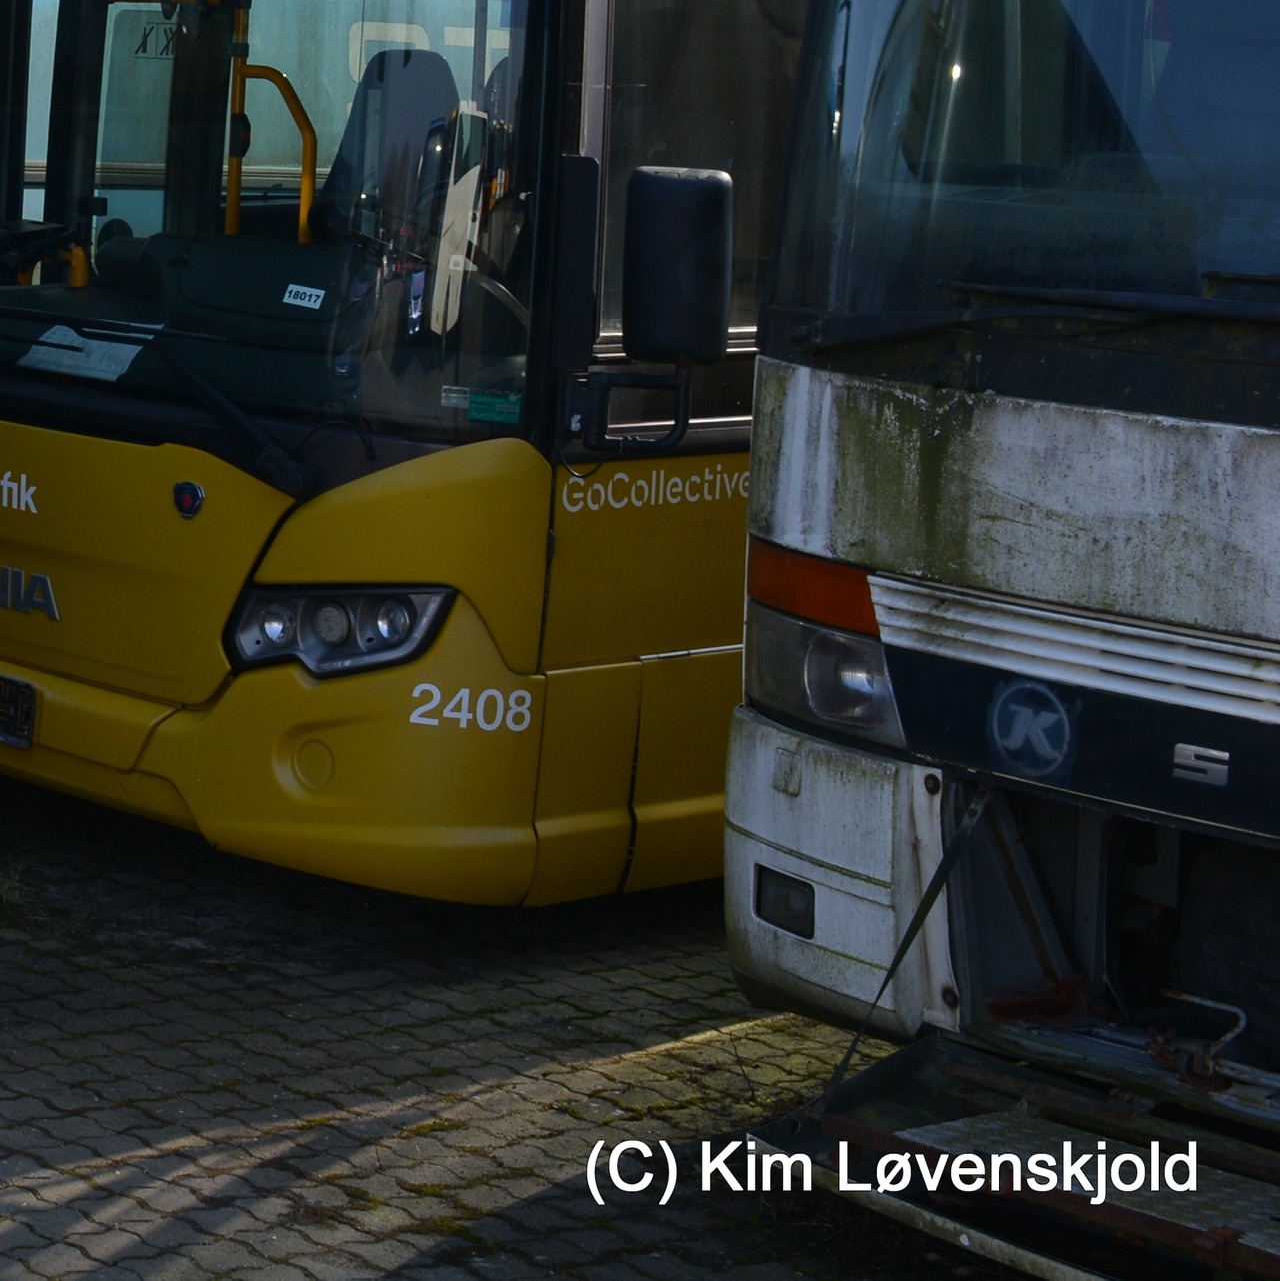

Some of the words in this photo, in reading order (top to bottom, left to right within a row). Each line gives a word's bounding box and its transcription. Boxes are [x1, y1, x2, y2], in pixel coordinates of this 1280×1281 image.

[288, 289, 321, 303] 18017
[562, 464, 750, 513] GoCollective
[409, 683, 532, 732] 2408
